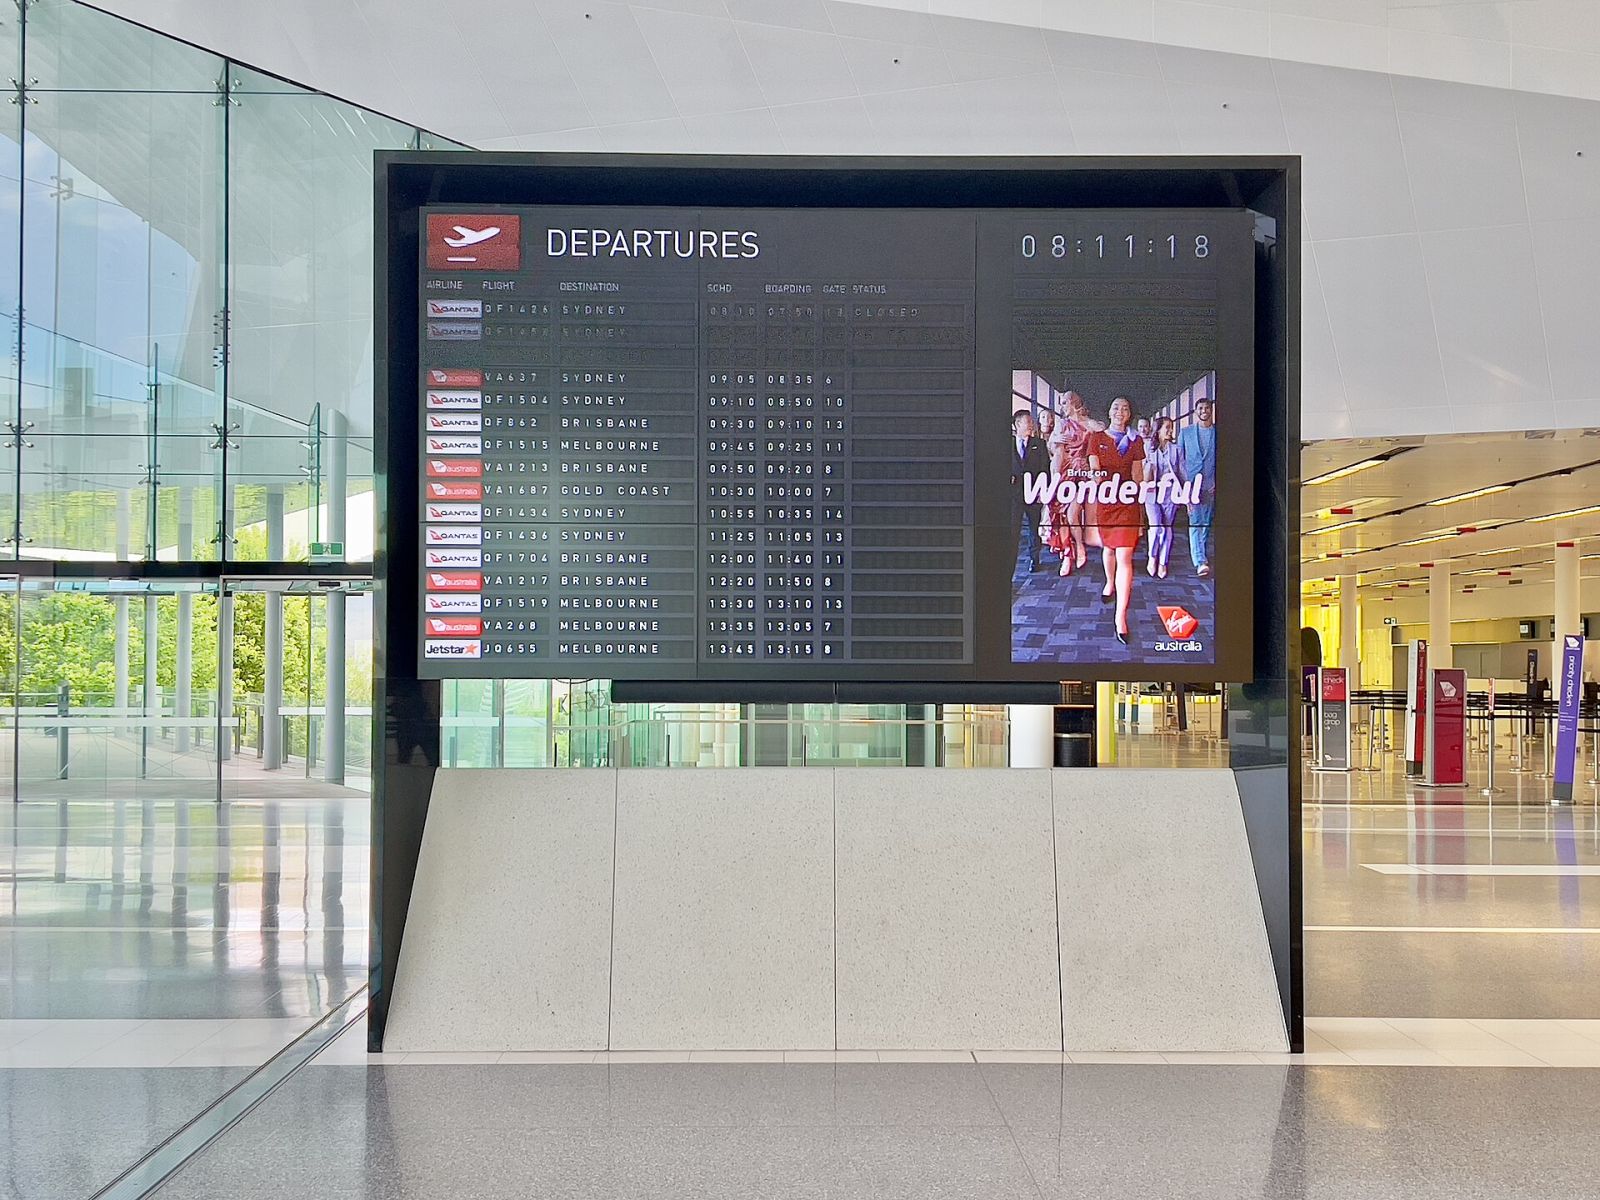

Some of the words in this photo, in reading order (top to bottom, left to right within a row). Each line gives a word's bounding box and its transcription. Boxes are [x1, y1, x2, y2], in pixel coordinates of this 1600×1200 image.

[547, 229, 760, 259] DEPARTURES
[1021, 234, 1210, 259] 08:11:18
[426, 280, 463, 290] AIRLINE
[482, 281, 515, 291] FLIGHT
[559, 282, 619, 292] DESTINATION
[707, 283, 732, 293] SCHD
[765, 284, 812, 294] BOARDING
[822, 284, 846, 294] GATE
[852, 284, 886, 294] STATUS
[442, 305, 479, 313] QANTAS
[562, 306, 625, 315] SYDNEY
[484, 372, 537, 382] VA637
[562, 373, 625, 383] SYDNEY
[825, 374, 832, 384] 6
[441, 396, 479, 404] QANTAS
[484, 395, 548, 404] QF1504
[562, 395, 625, 405] SYDNEY
[710, 397, 754, 406] 09:10
[767, 397, 812, 407] 08:50
[826, 397, 843, 407] 10
[441, 418, 479, 426] QANTAS
[484, 417, 537, 427] QF862
[562, 418, 648, 428] BRISBANE
[710, 419, 754, 429] 09:30
[767, 419, 812, 429] 09:10
[826, 420, 843, 429] 13
[441, 441, 479, 449] QANTAS
[484, 440, 548, 450] QF1515
[560, 440, 659, 451] MELBOURNE
[710, 442, 754, 451] 09:45
[767, 442, 812, 452] 09:25
[826, 442, 841, 452] 11
[484, 462, 548, 472] VA1213
[561, 463, 648, 473] BRISBANE
[710, 464, 754, 474] 09:50
[767, 464, 812, 474] 09:20
[825, 465, 831, 474] 8
[1067, 468, 1093, 478] Bring
[484, 485, 548, 495] VA1687
[561, 486, 603, 495] GOLD
[617, 486, 670, 496] COAST
[710, 487, 754, 496] 10:30
[768, 487, 812, 497] 10:00
[825, 487, 831, 496] 7
[1023, 471, 1203, 505] Wonderful
[441, 509, 479, 517] QANTAS
[484, 507, 548, 517] QF1434
[561, 508, 625, 518] SYDNEY
[710, 509, 754, 519] 10:55
[768, 509, 812, 519] 10:35
[826, 510, 842, 519] 14
[441, 531, 479, 539] QANTAS
[484, 530, 548, 540] QF1436
[561, 531, 625, 541] SYDNEY
[710, 532, 754, 542] 11:25
[768, 532, 812, 542] 11:05
[825, 532, 843, 542] 13
[441, 554, 479, 562] QANTAS
[483, 553, 547, 563] QF1704
[561, 553, 647, 563] BRISBANE
[710, 554, 754, 564] 12:00
[768, 554, 812, 564] 11:40
[826, 555, 841, 564] 11
[483, 576, 548, 585] VA1217
[561, 576, 647, 586] BRISBANE
[710, 576, 754, 586] 12:20
[768, 577, 812, 587] 11:50
[824, 577, 831, 587] 8
[441, 599, 479, 607] QANTAS
[483, 598, 548, 608] QF1519
[560, 598, 658, 608] MELBOURNE
[710, 599, 754, 609] 13:30
[767, 599, 812, 609] 13:10
[825, 599, 842, 609] 13
[483, 621, 536, 630] VA268
[560, 621, 658, 631] MELBOURNE
[710, 621, 754, 631] 13:35
[767, 621, 812, 632] 13:05
[824, 622, 831, 631] 7
[427, 643, 464, 654] Jetstar
[484, 644, 536, 653] JQ655
[559, 644, 658, 654] MELBOURNE
[709, 644, 753, 654] 13:45
[767, 644, 811, 654] 13:15
[824, 644, 831, 654] 8
[1154, 640, 1203, 652] australia
